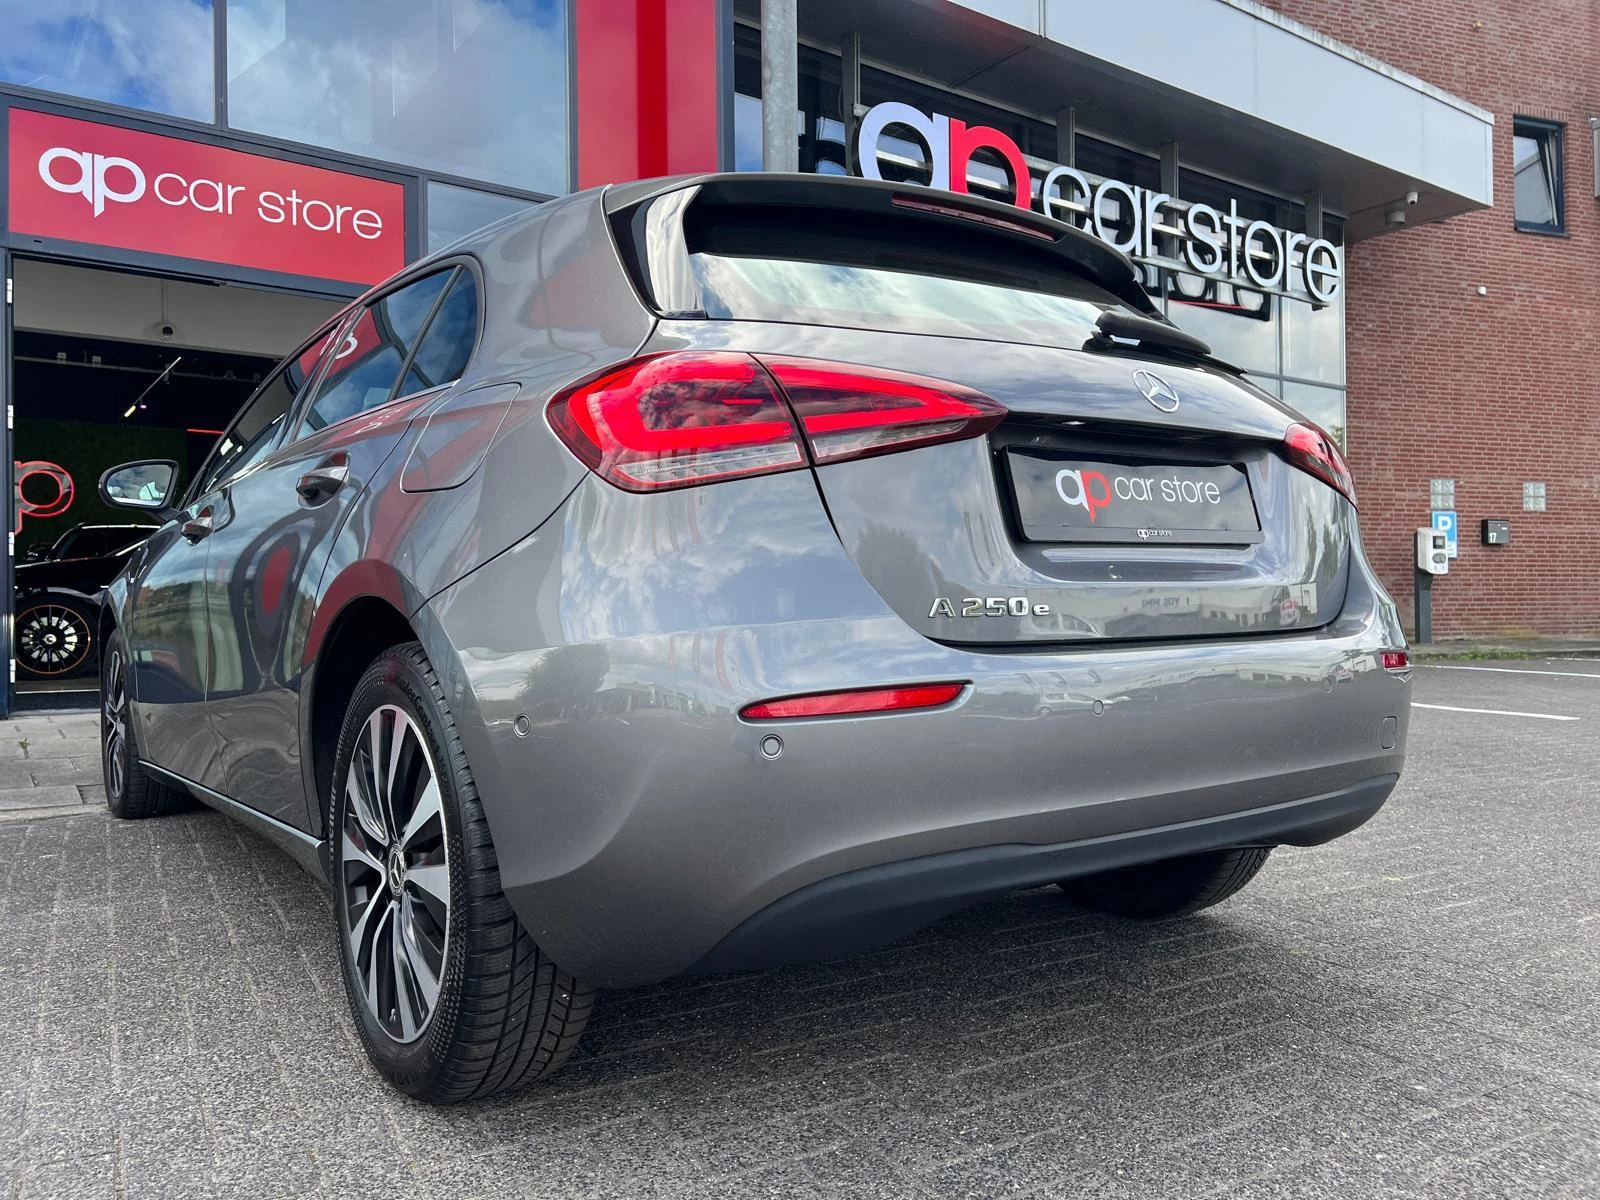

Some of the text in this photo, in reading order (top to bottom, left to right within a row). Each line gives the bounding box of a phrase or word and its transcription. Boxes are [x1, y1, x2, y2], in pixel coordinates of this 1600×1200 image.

[38, 147, 383, 240] ap car store
[1043, 166, 1169, 257] car
[1187, 198, 1341, 301] store
[1055, 469, 1221, 524] ap car store
[1489, 532, 1497, 544] 17
[928, 597, 956, 618] A
